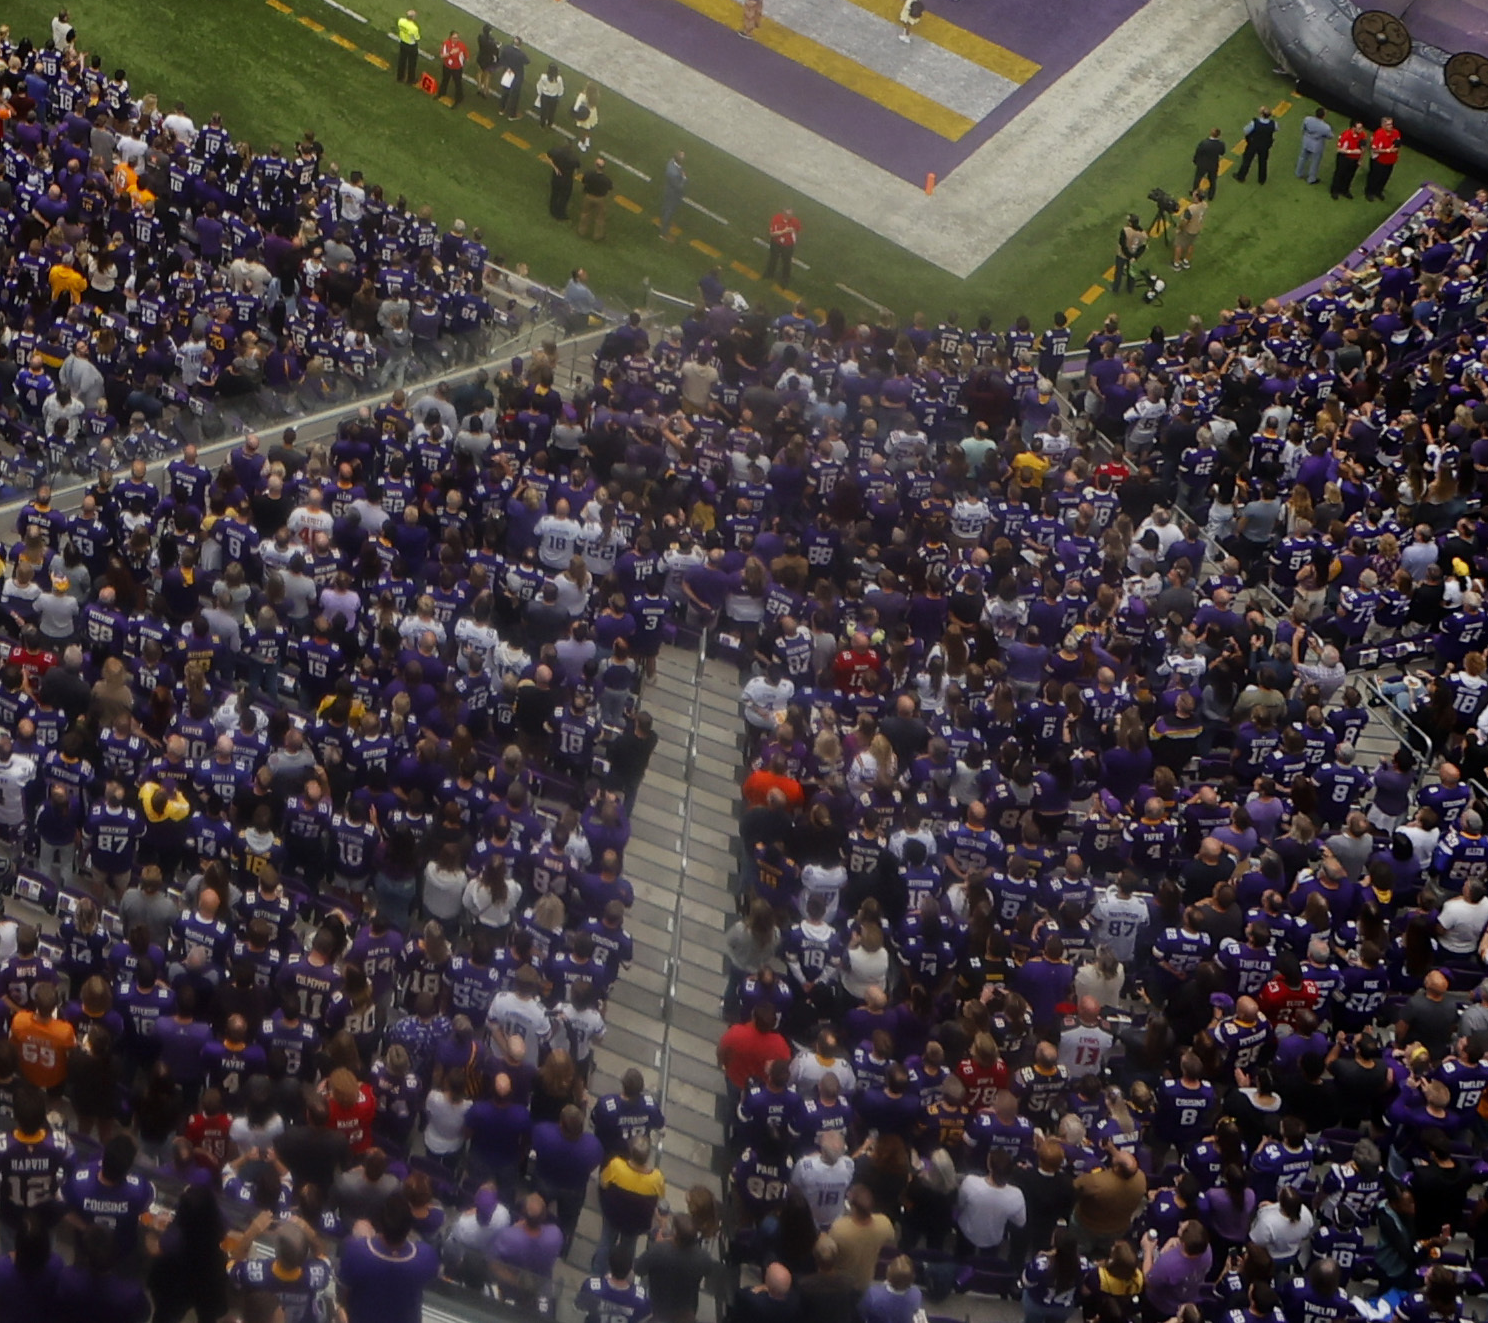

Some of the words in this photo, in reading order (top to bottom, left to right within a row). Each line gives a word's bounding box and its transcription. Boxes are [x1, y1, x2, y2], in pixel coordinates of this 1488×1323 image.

[1330, 783, 1349, 804] 8
[96, 834, 128, 855] 87
[338, 839, 364, 866] 18
[1109, 920, 1137, 939] 87
[1238, 959, 1272, 972] THIELEN
[294, 972, 332, 992] CULPEPPER
[1075, 1044, 1100, 1066] 13
[1175, 1098, 1207, 1109] COUSINS
[9, 1157, 51, 1173] HARVIN
[755, 1163, 779, 1177] PAGE
[6, 1172, 58, 1208] 12
[82, 1198, 130, 1214] COUSINS
